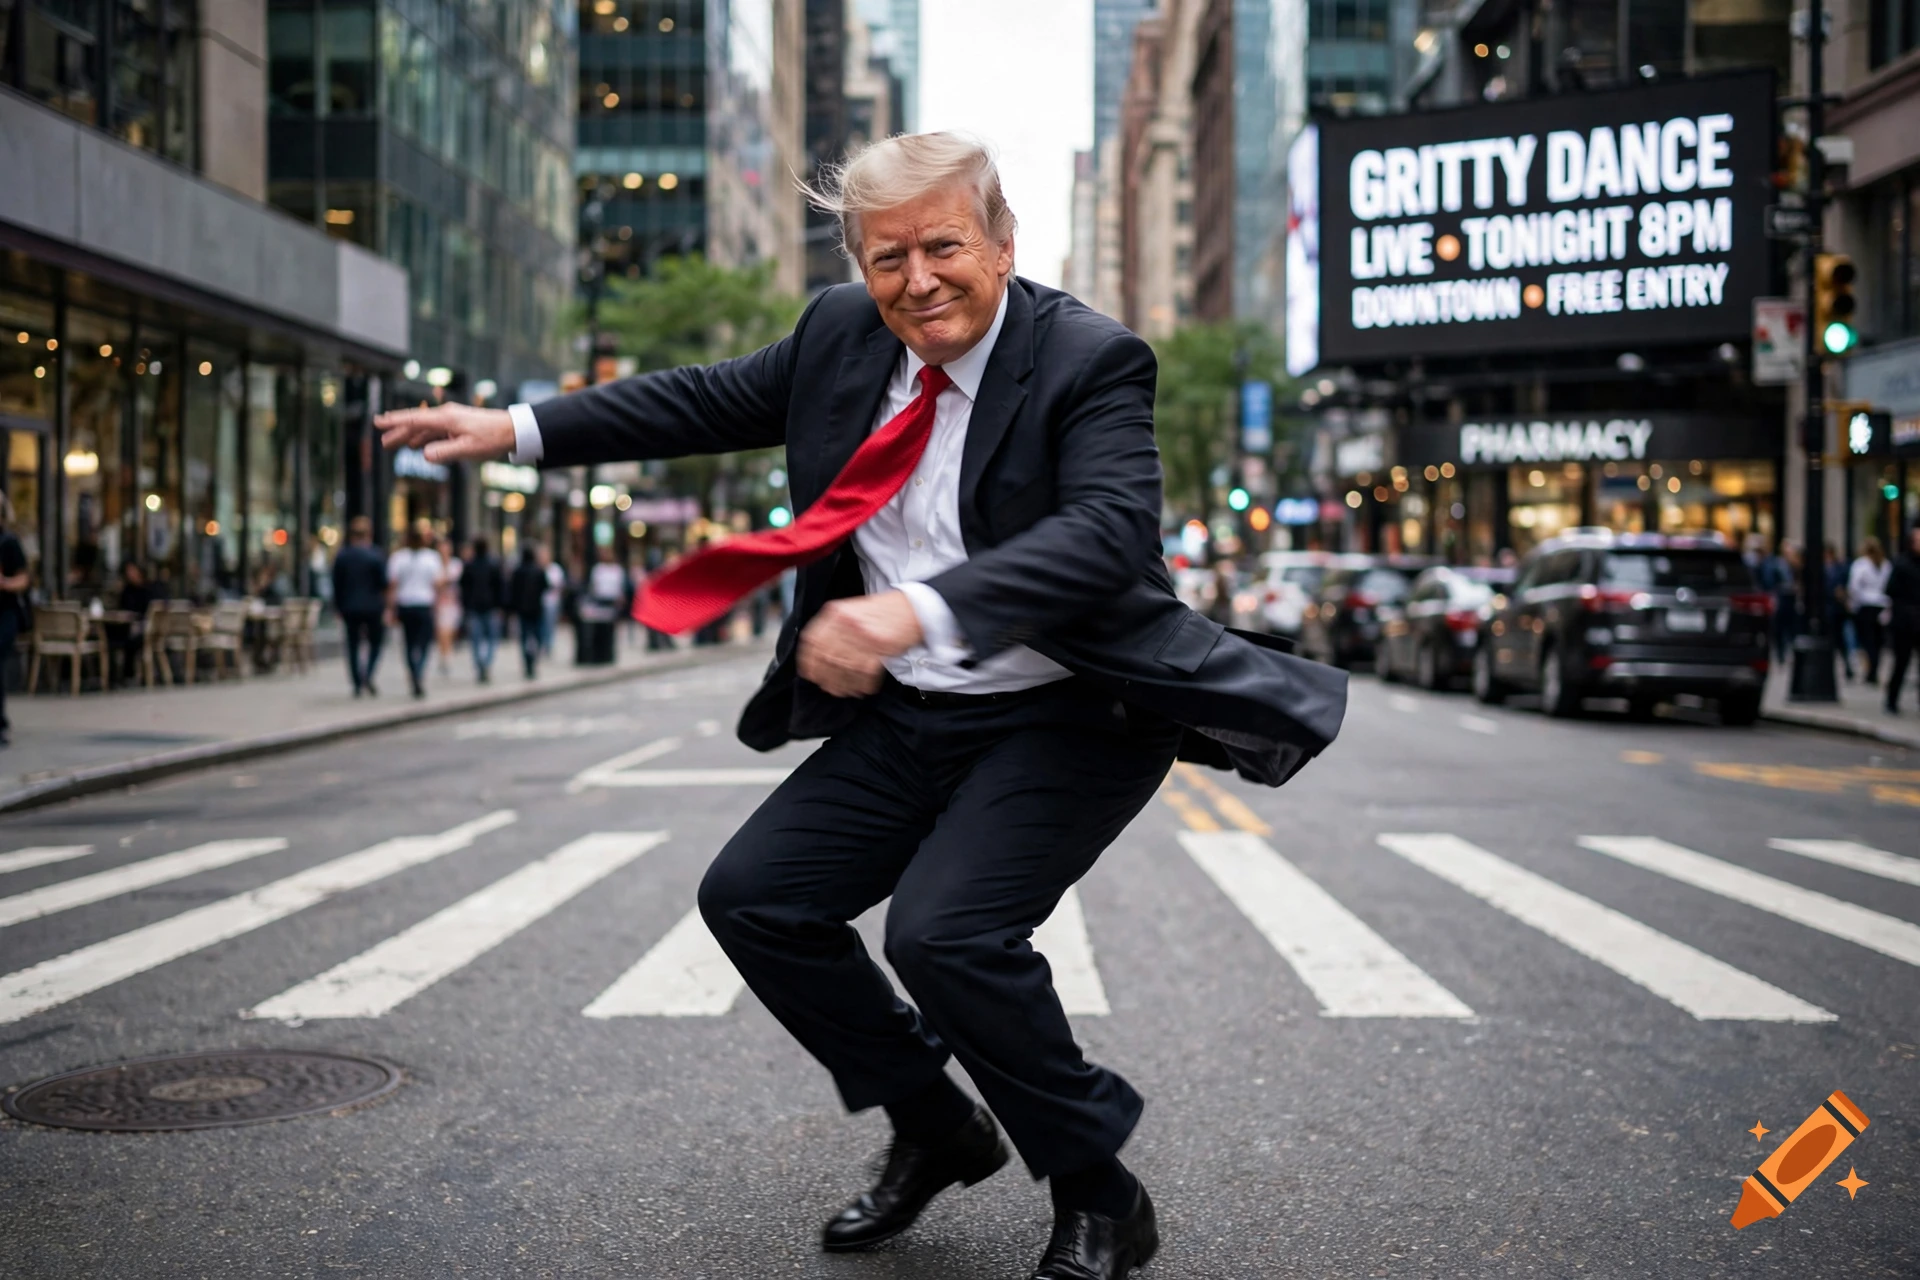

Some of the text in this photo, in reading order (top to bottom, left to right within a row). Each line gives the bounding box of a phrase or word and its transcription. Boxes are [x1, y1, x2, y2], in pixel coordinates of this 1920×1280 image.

[1349, 113, 1735, 221] GRITTY DANCE
[1350, 197, 1733, 280] LIVE TONIGHT 8PM
[1351, 262, 1730, 329] DOWNTOWN FREE ENTRY
[1459, 419, 1653, 464] PHARMACY
